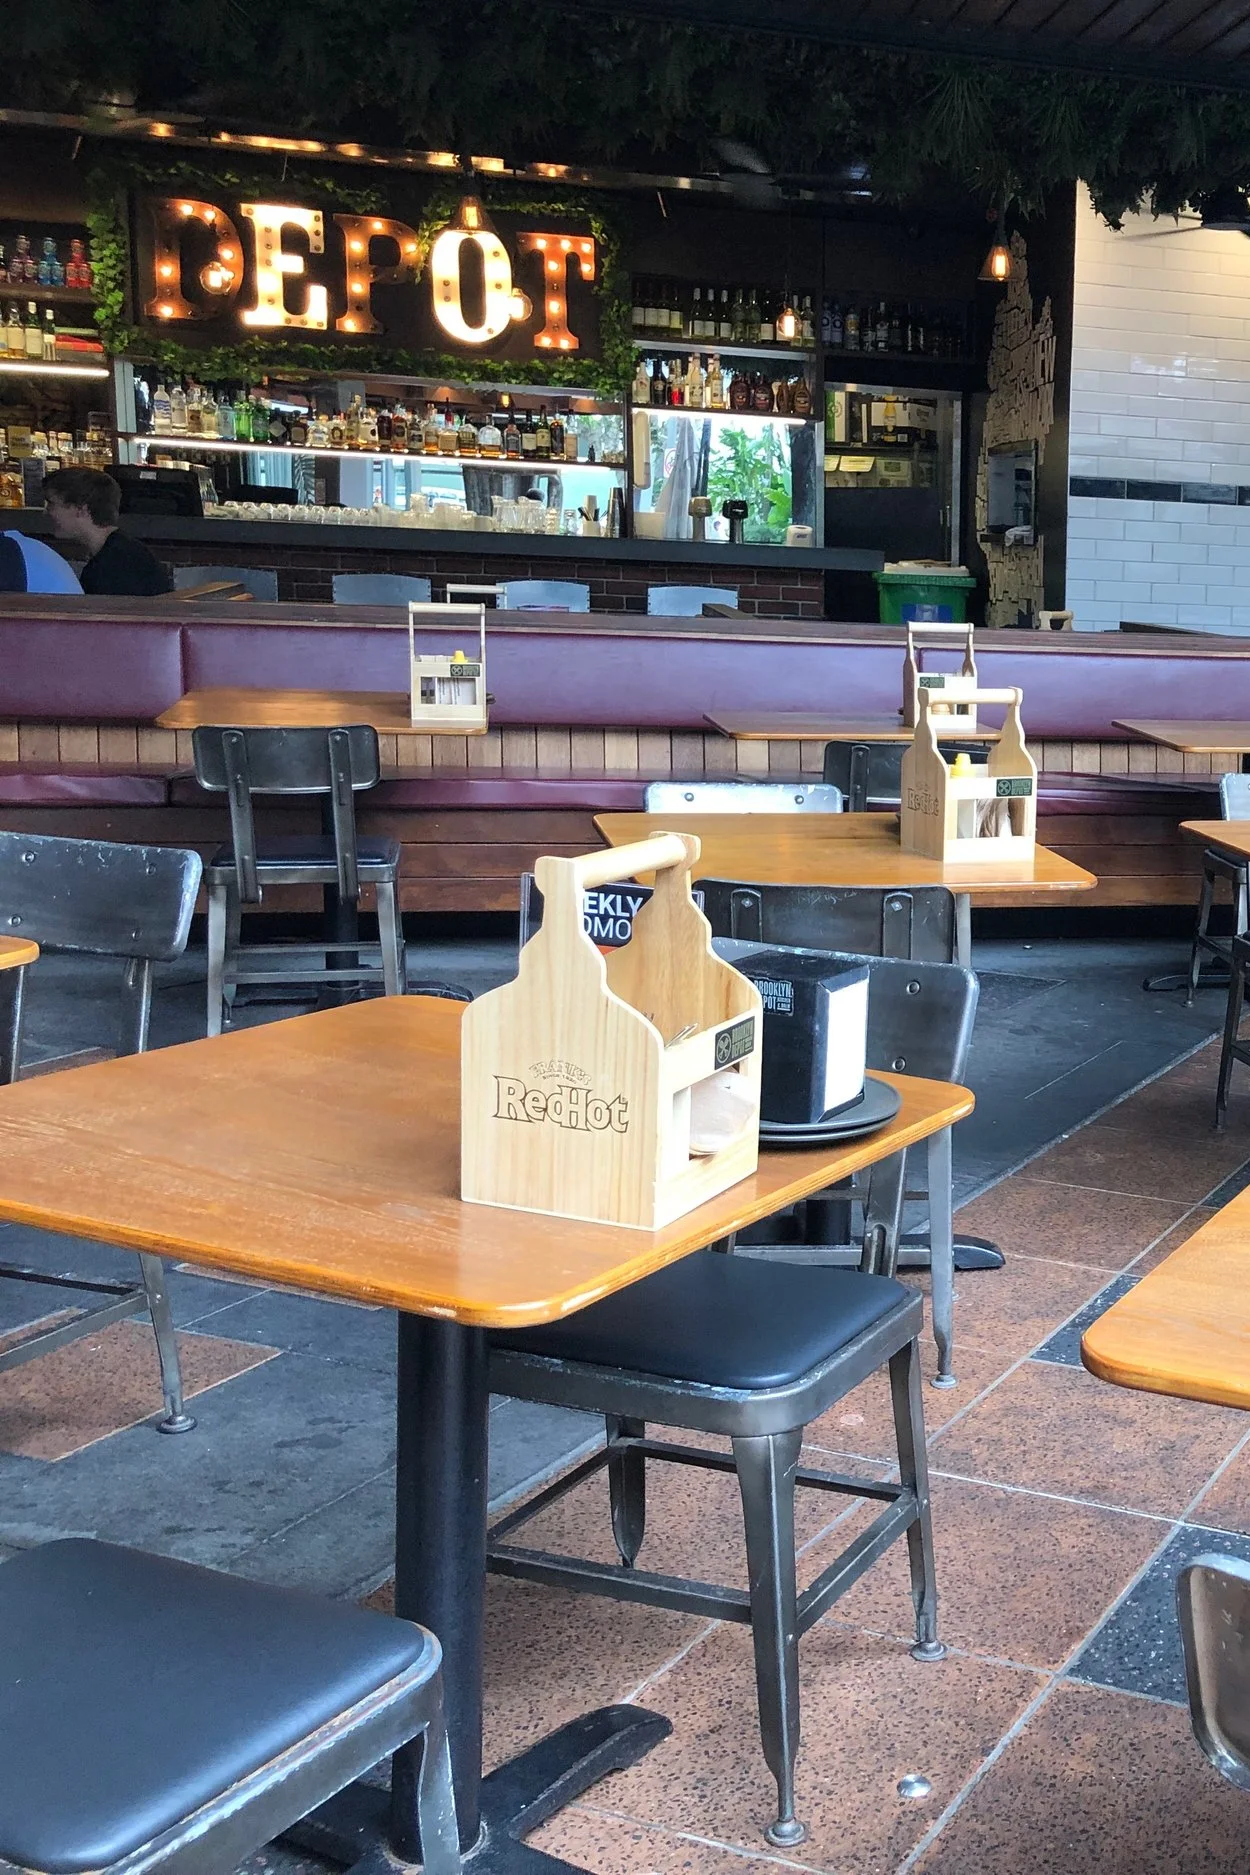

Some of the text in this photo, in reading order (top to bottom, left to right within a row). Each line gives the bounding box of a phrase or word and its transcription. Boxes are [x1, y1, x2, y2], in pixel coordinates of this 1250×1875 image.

[144, 198, 596, 350] DEPOT
[584, 891, 643, 917] EKLY
[763, 996, 777, 1011] POT
[492, 1074, 630, 1134] RedHot
